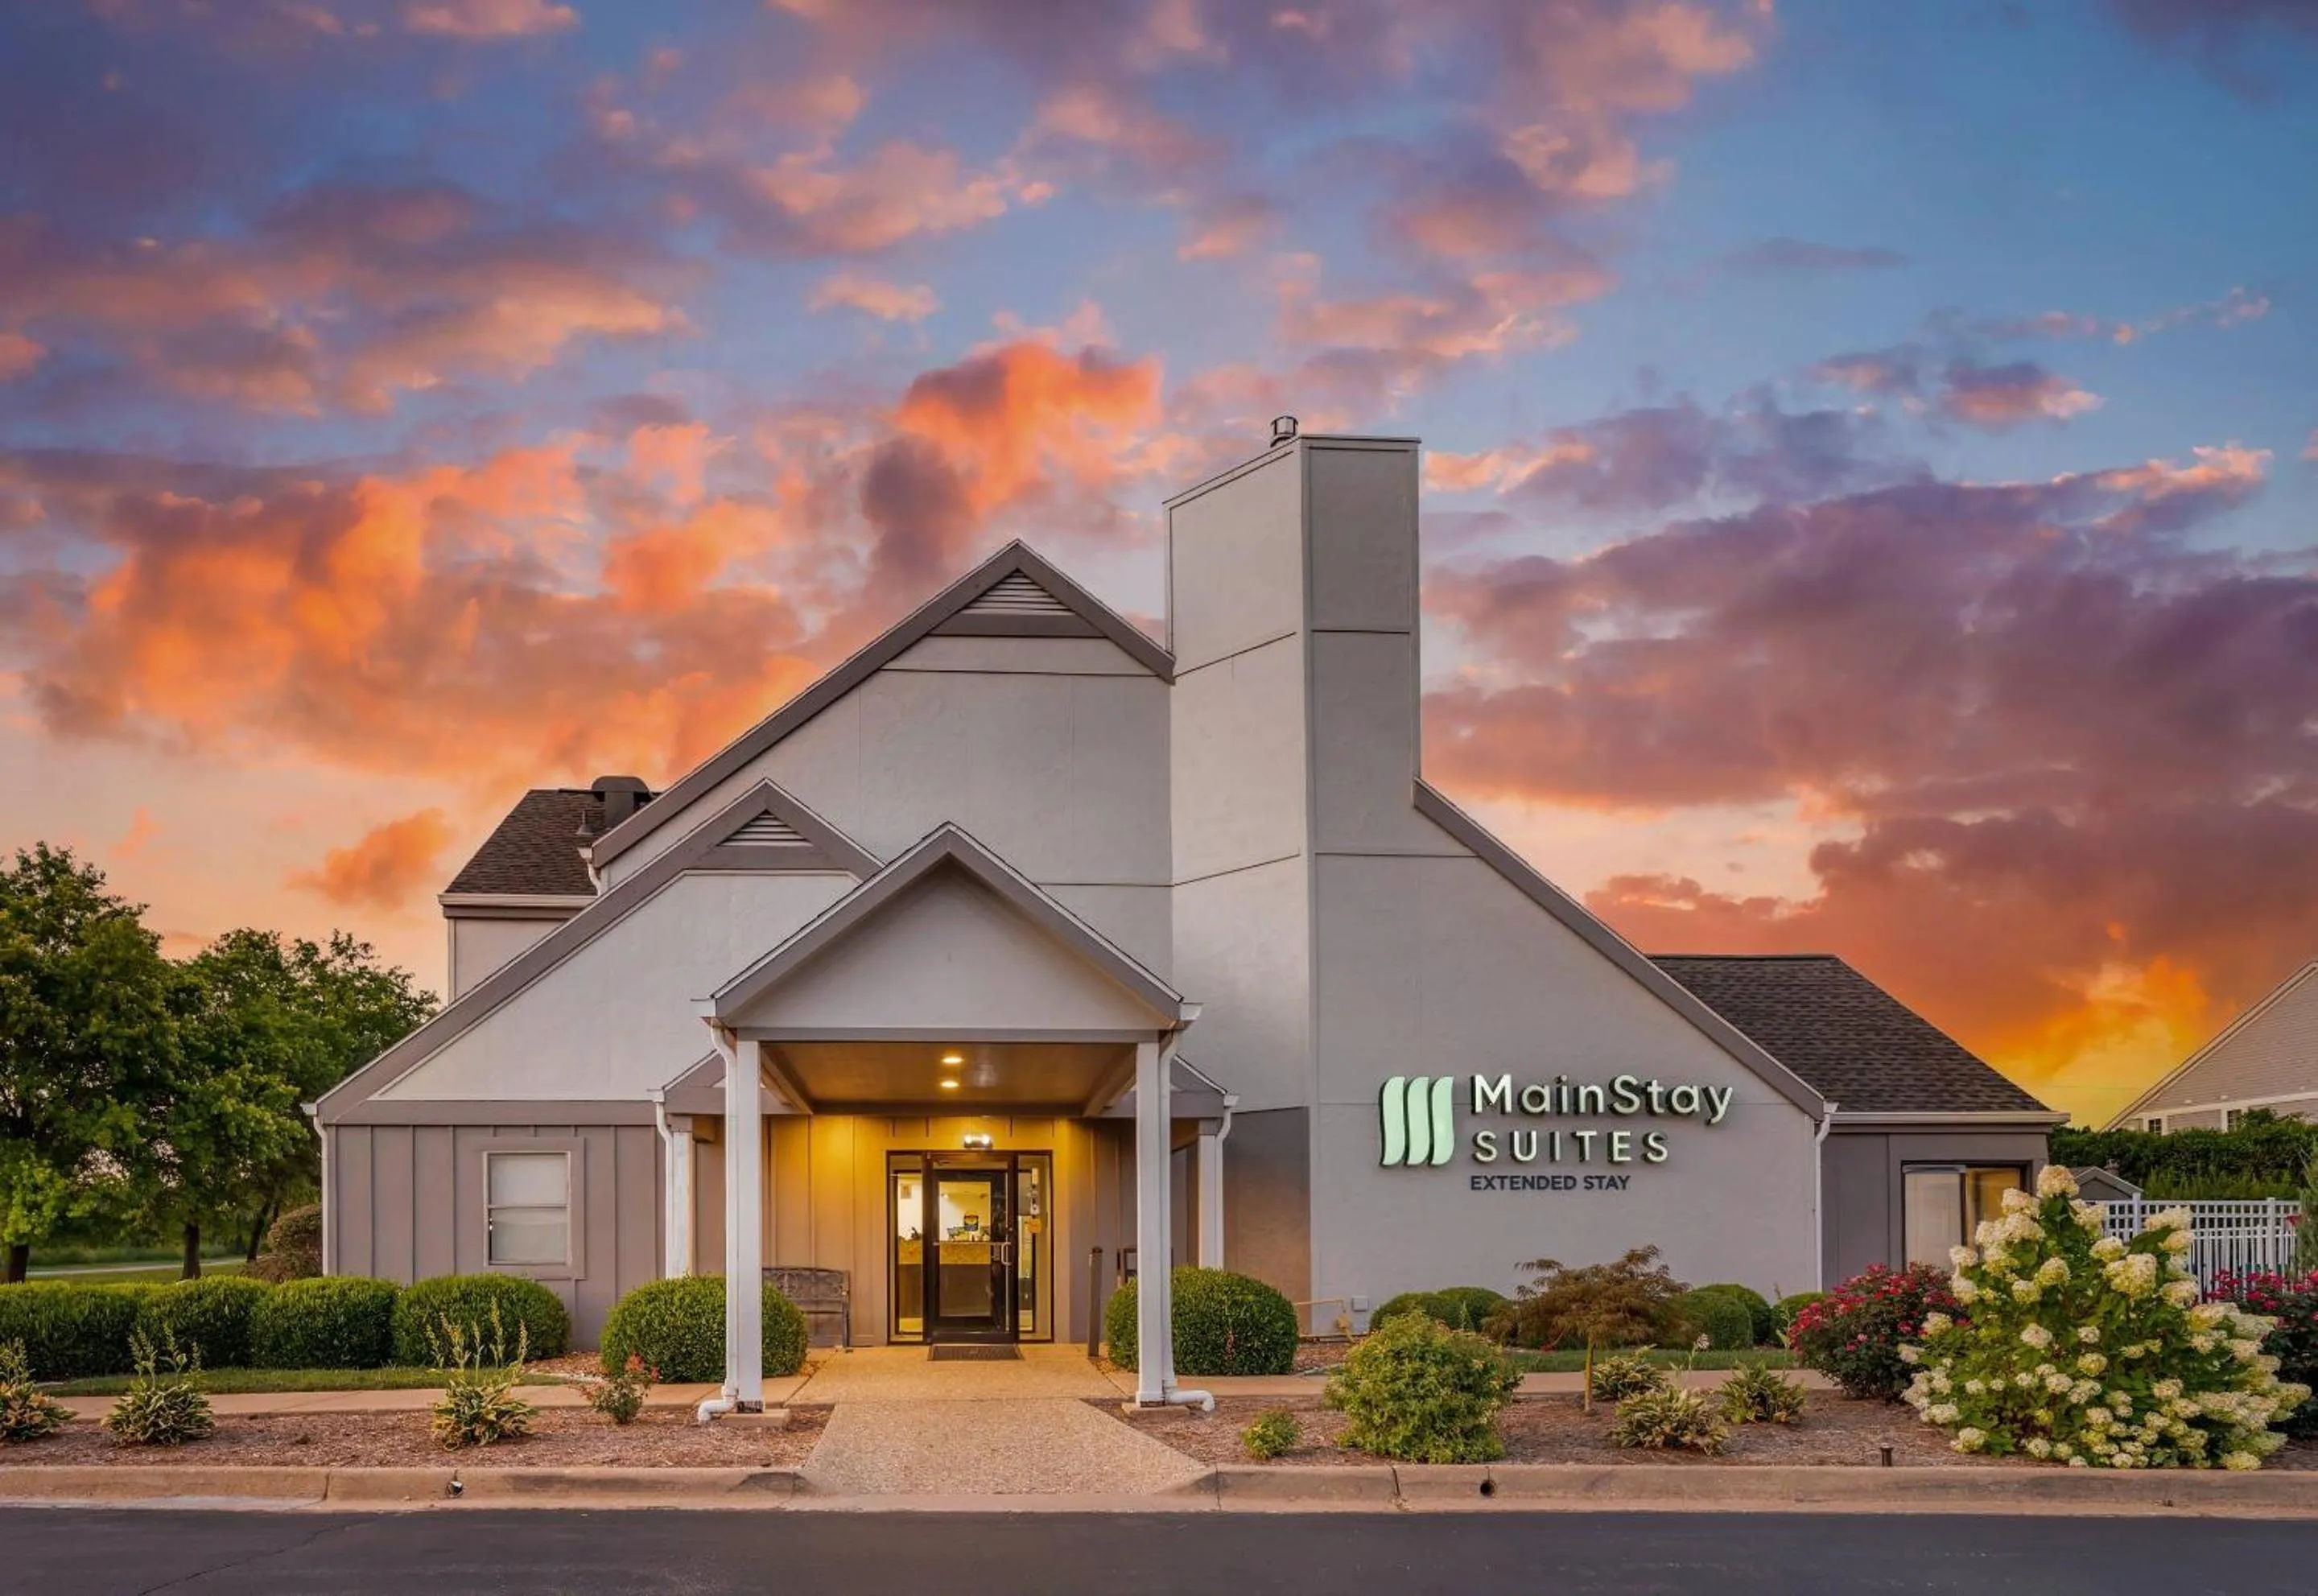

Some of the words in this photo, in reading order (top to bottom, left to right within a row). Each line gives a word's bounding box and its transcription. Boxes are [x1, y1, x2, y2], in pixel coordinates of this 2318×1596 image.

[1471, 1074, 1733, 1124] MainStay
[1472, 1130, 1668, 1163] SUITES
[1470, 1175, 1577, 1190] EXTENDED
[1583, 1175, 1631, 1190] STAY
